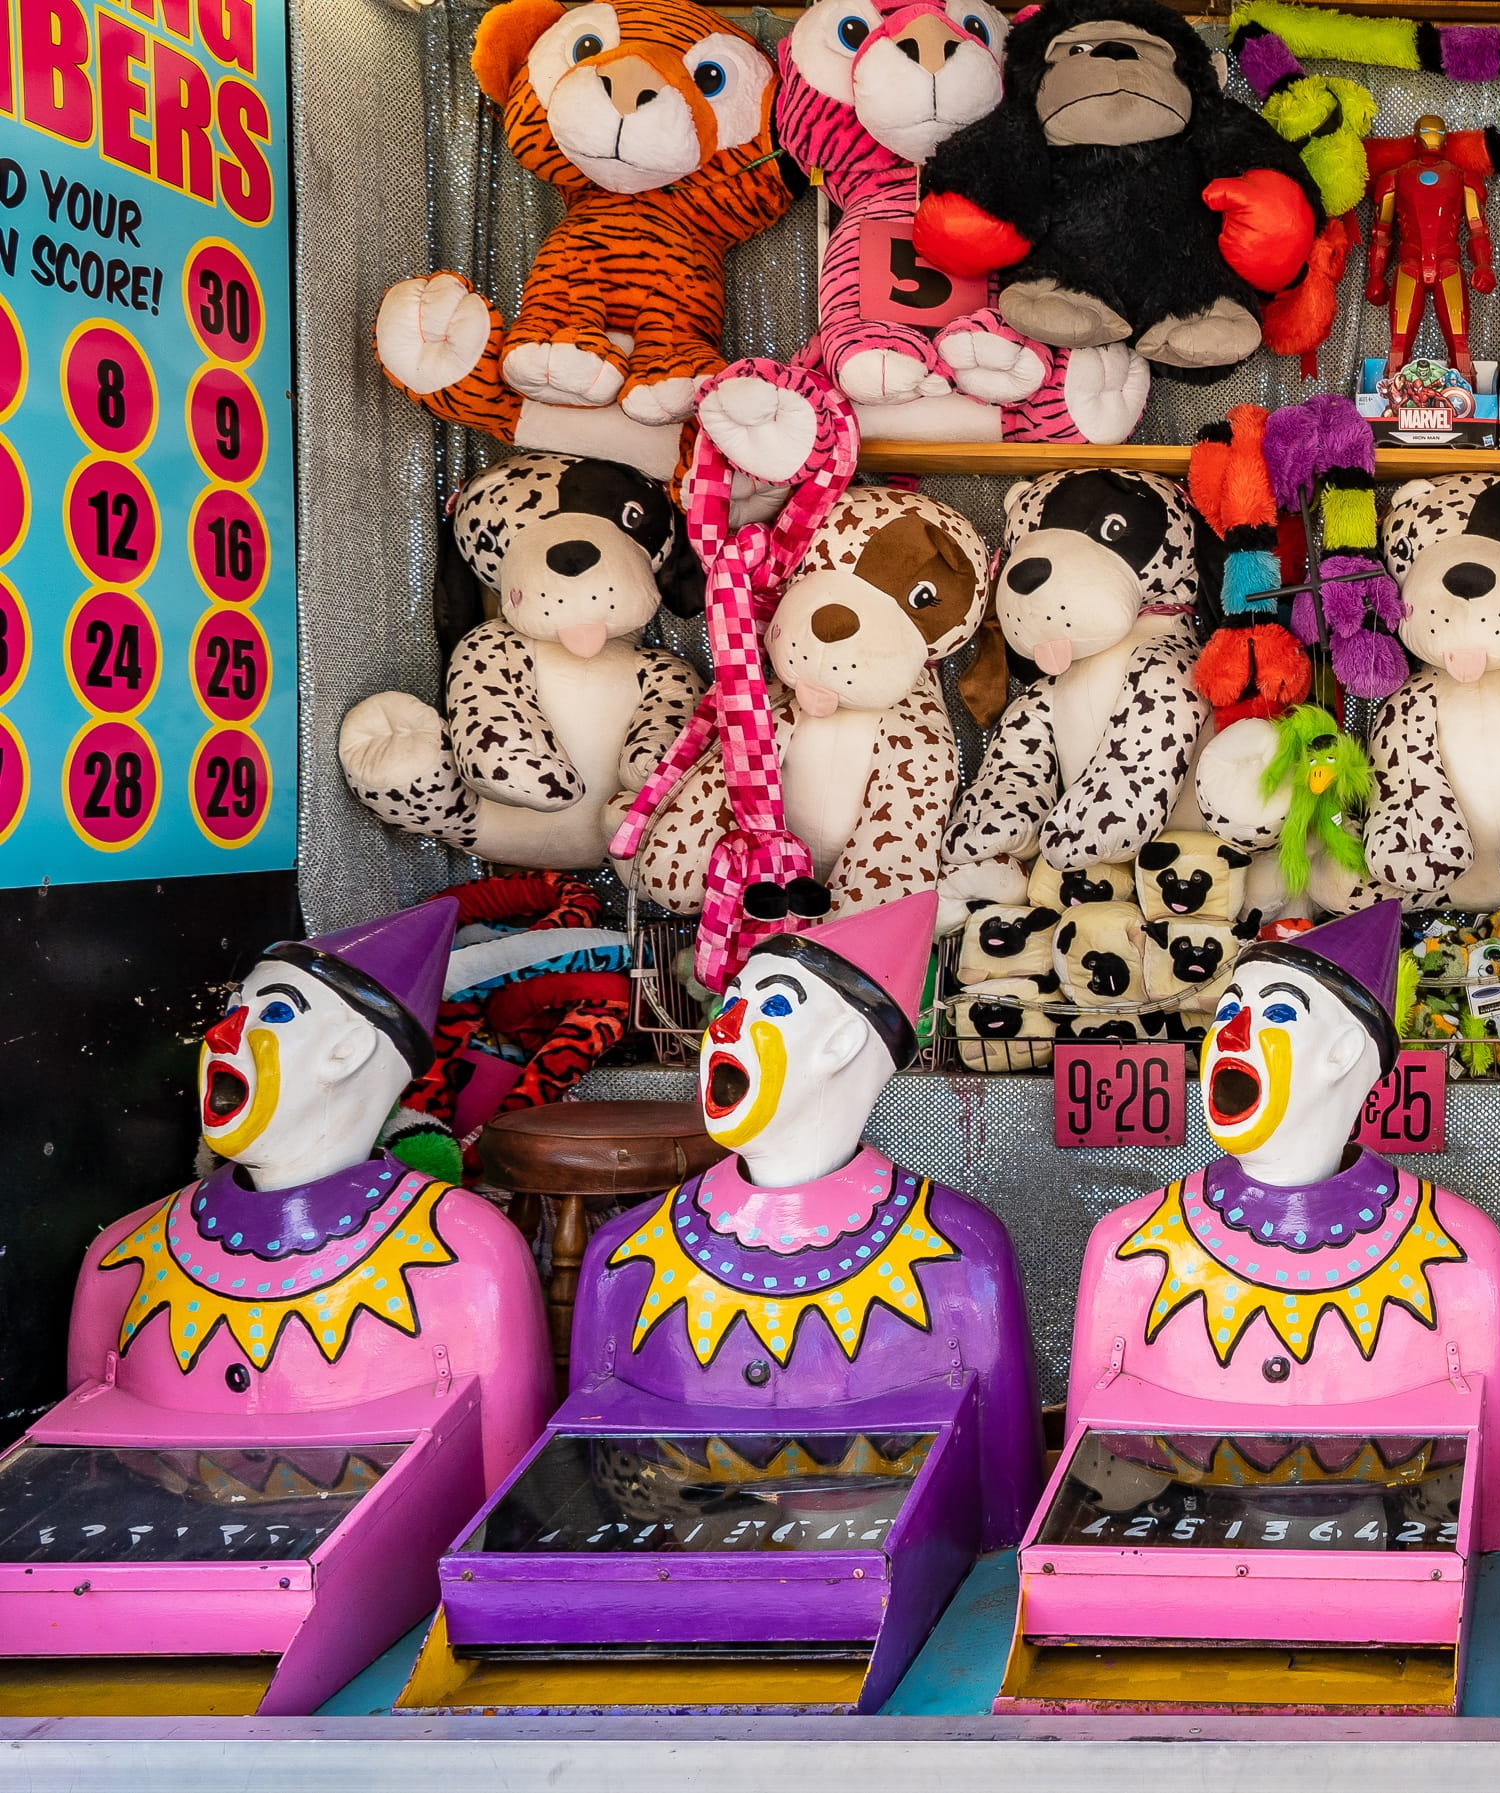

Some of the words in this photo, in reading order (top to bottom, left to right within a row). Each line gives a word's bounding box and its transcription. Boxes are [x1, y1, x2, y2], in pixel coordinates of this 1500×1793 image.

[0, 0, 272, 222] BERS
[40, 170, 142, 248] YOUR
[31, 235, 163, 316] SCORE!
[200, 270, 250, 343] 30
[889, 238, 952, 309] 5
[97, 359, 125, 428] 8
[1400, 410, 1450, 429] MARVEL
[216, 397, 240, 460] 9
[88, 490, 138, 561] 12
[208, 517, 252, 581] 16
[86, 621, 142, 689] 24
[207, 636, 256, 700] 25
[83, 752, 142, 818] 28
[207, 756, 256, 818] 29
[1123, 1517, 1158, 1536] 2
[1172, 1518, 1204, 1538] 5
[1224, 1520, 1242, 1538] 1
[1261, 1520, 1290, 1541] 3
[1309, 1520, 1342, 1541] 6
[1354, 1520, 1387, 1541] 4
[1395, 1521, 1426, 1541] 2
